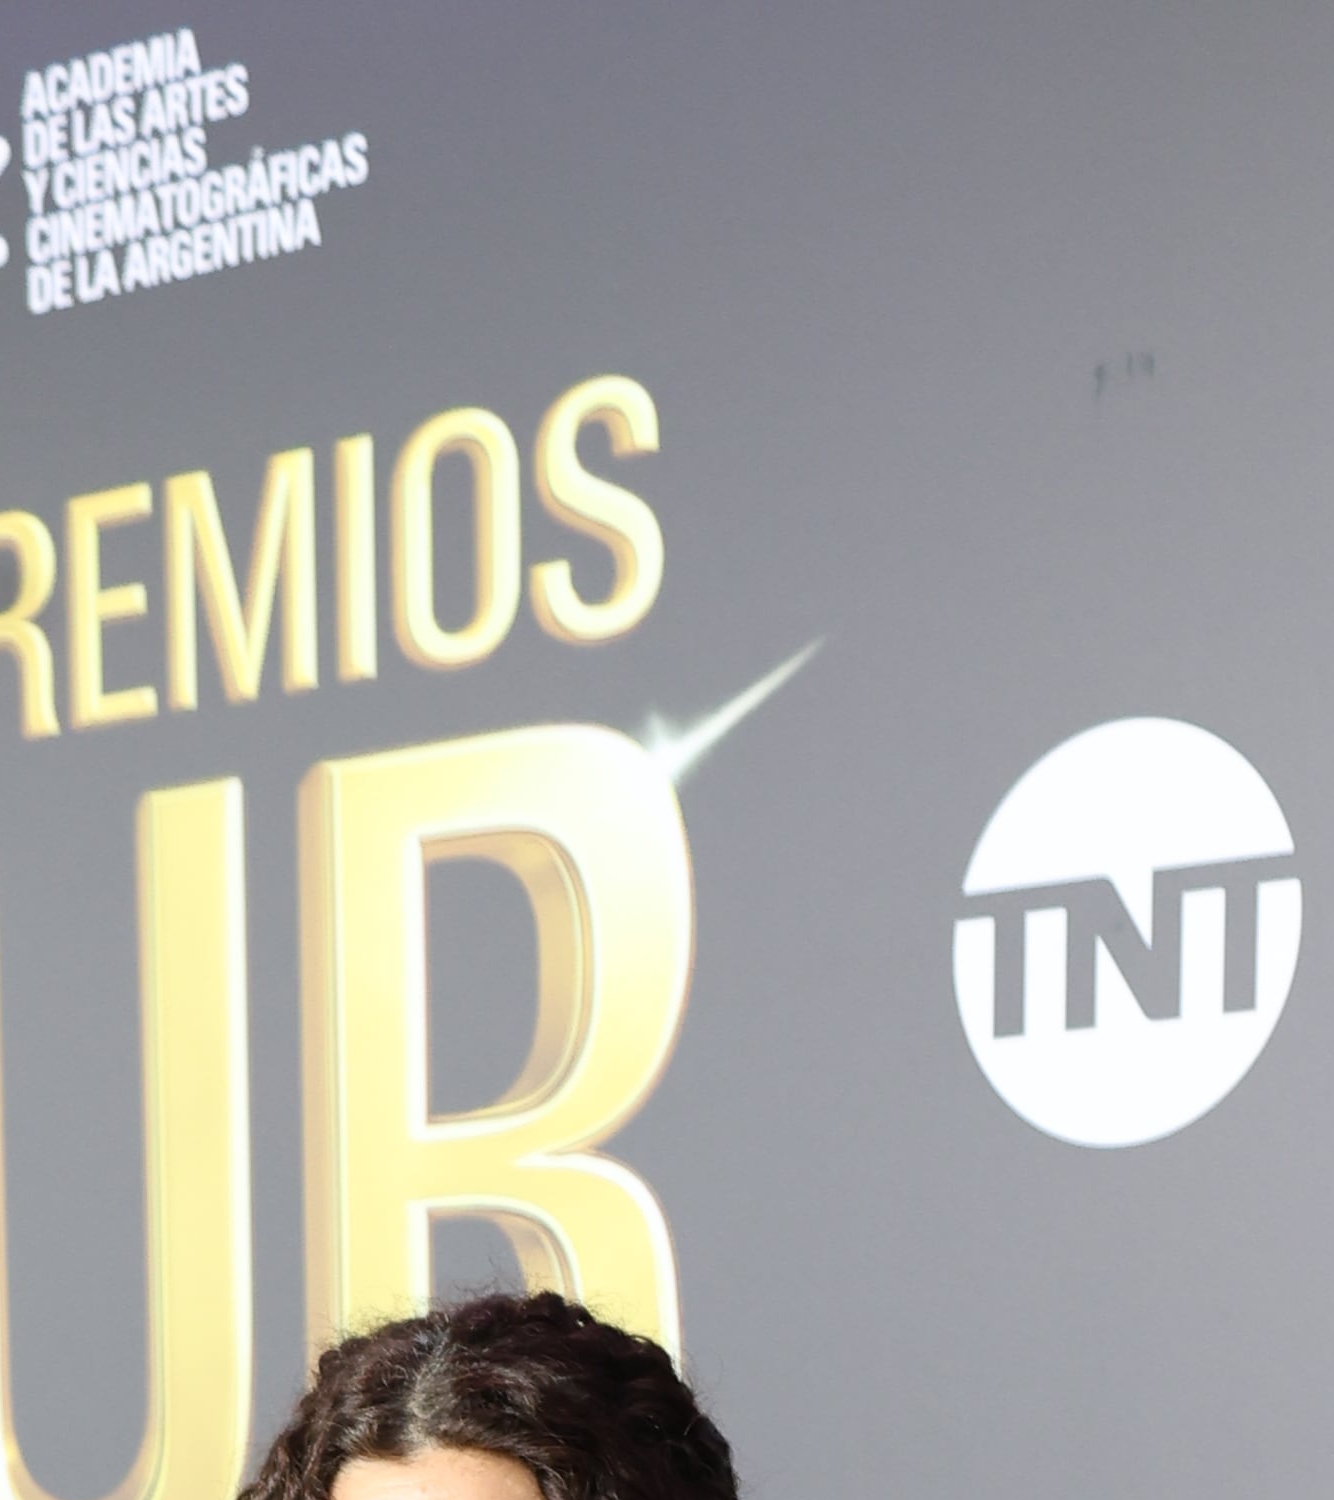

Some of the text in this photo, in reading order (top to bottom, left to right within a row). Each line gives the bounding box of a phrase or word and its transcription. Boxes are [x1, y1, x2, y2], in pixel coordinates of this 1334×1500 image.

[21, 28, 202, 121] ACADEMIA
[23, 62, 250, 170] DE LAS ARTES
[22, 126, 208, 216] Y CIENCIAS
[26, 132, 368, 266] CINEMATOGRÁFICAS
[26, 197, 322, 315] DE LA ARGENTINA
